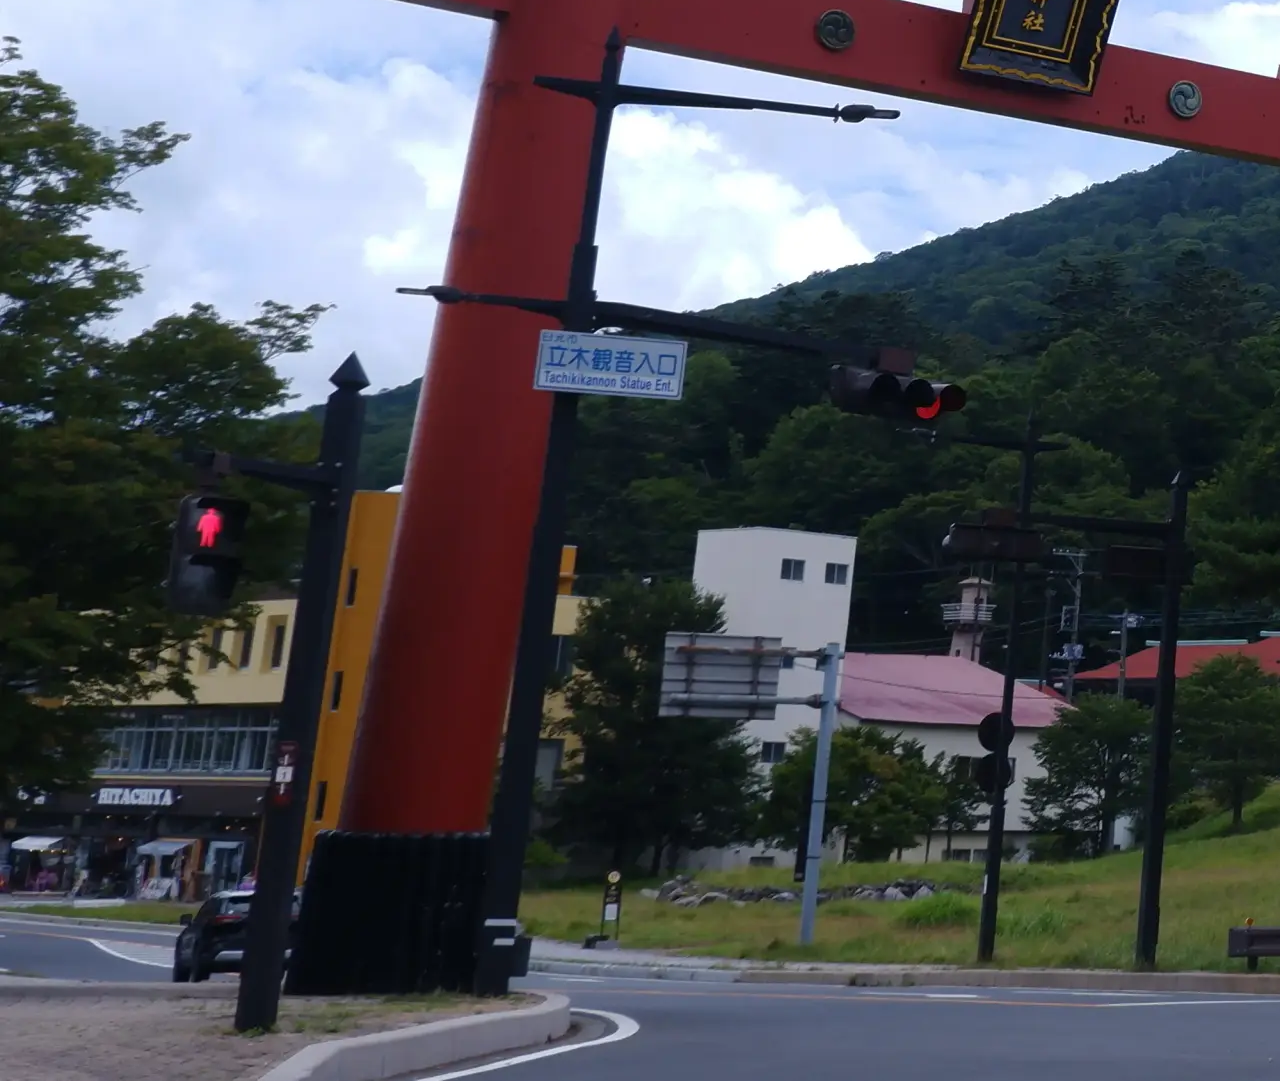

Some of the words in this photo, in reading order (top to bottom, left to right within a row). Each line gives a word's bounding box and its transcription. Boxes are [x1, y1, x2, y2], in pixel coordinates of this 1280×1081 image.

[545, 345, 678, 376] 立木観音入口
[543, 370, 617, 388] Tachikikannon
[619, 375, 652, 391] Statue
[654, 379, 674, 393] Ent.
[98, 788, 173, 806] HITACHIYA
